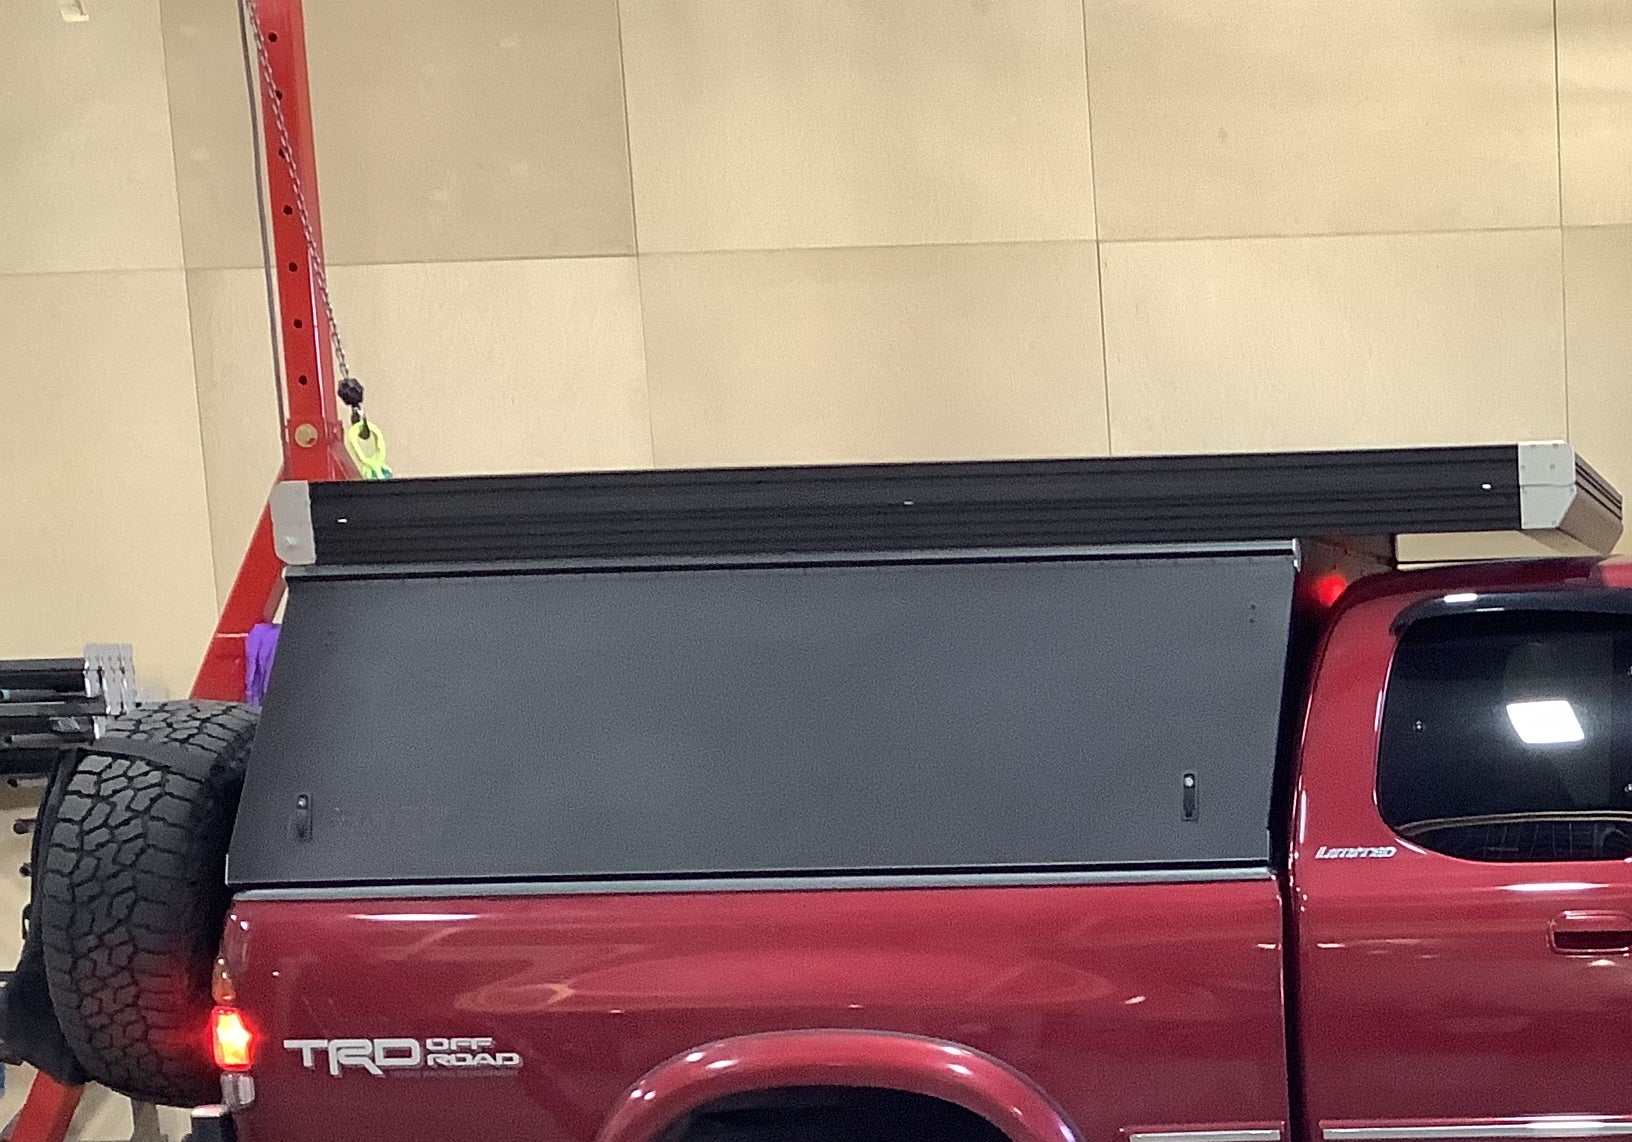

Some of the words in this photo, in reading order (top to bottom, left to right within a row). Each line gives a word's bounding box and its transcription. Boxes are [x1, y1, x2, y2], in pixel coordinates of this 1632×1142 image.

[425, 1037, 493, 1050] OFF
[283, 1038, 421, 1077] TRD
[426, 1052, 522, 1067] ROAD
